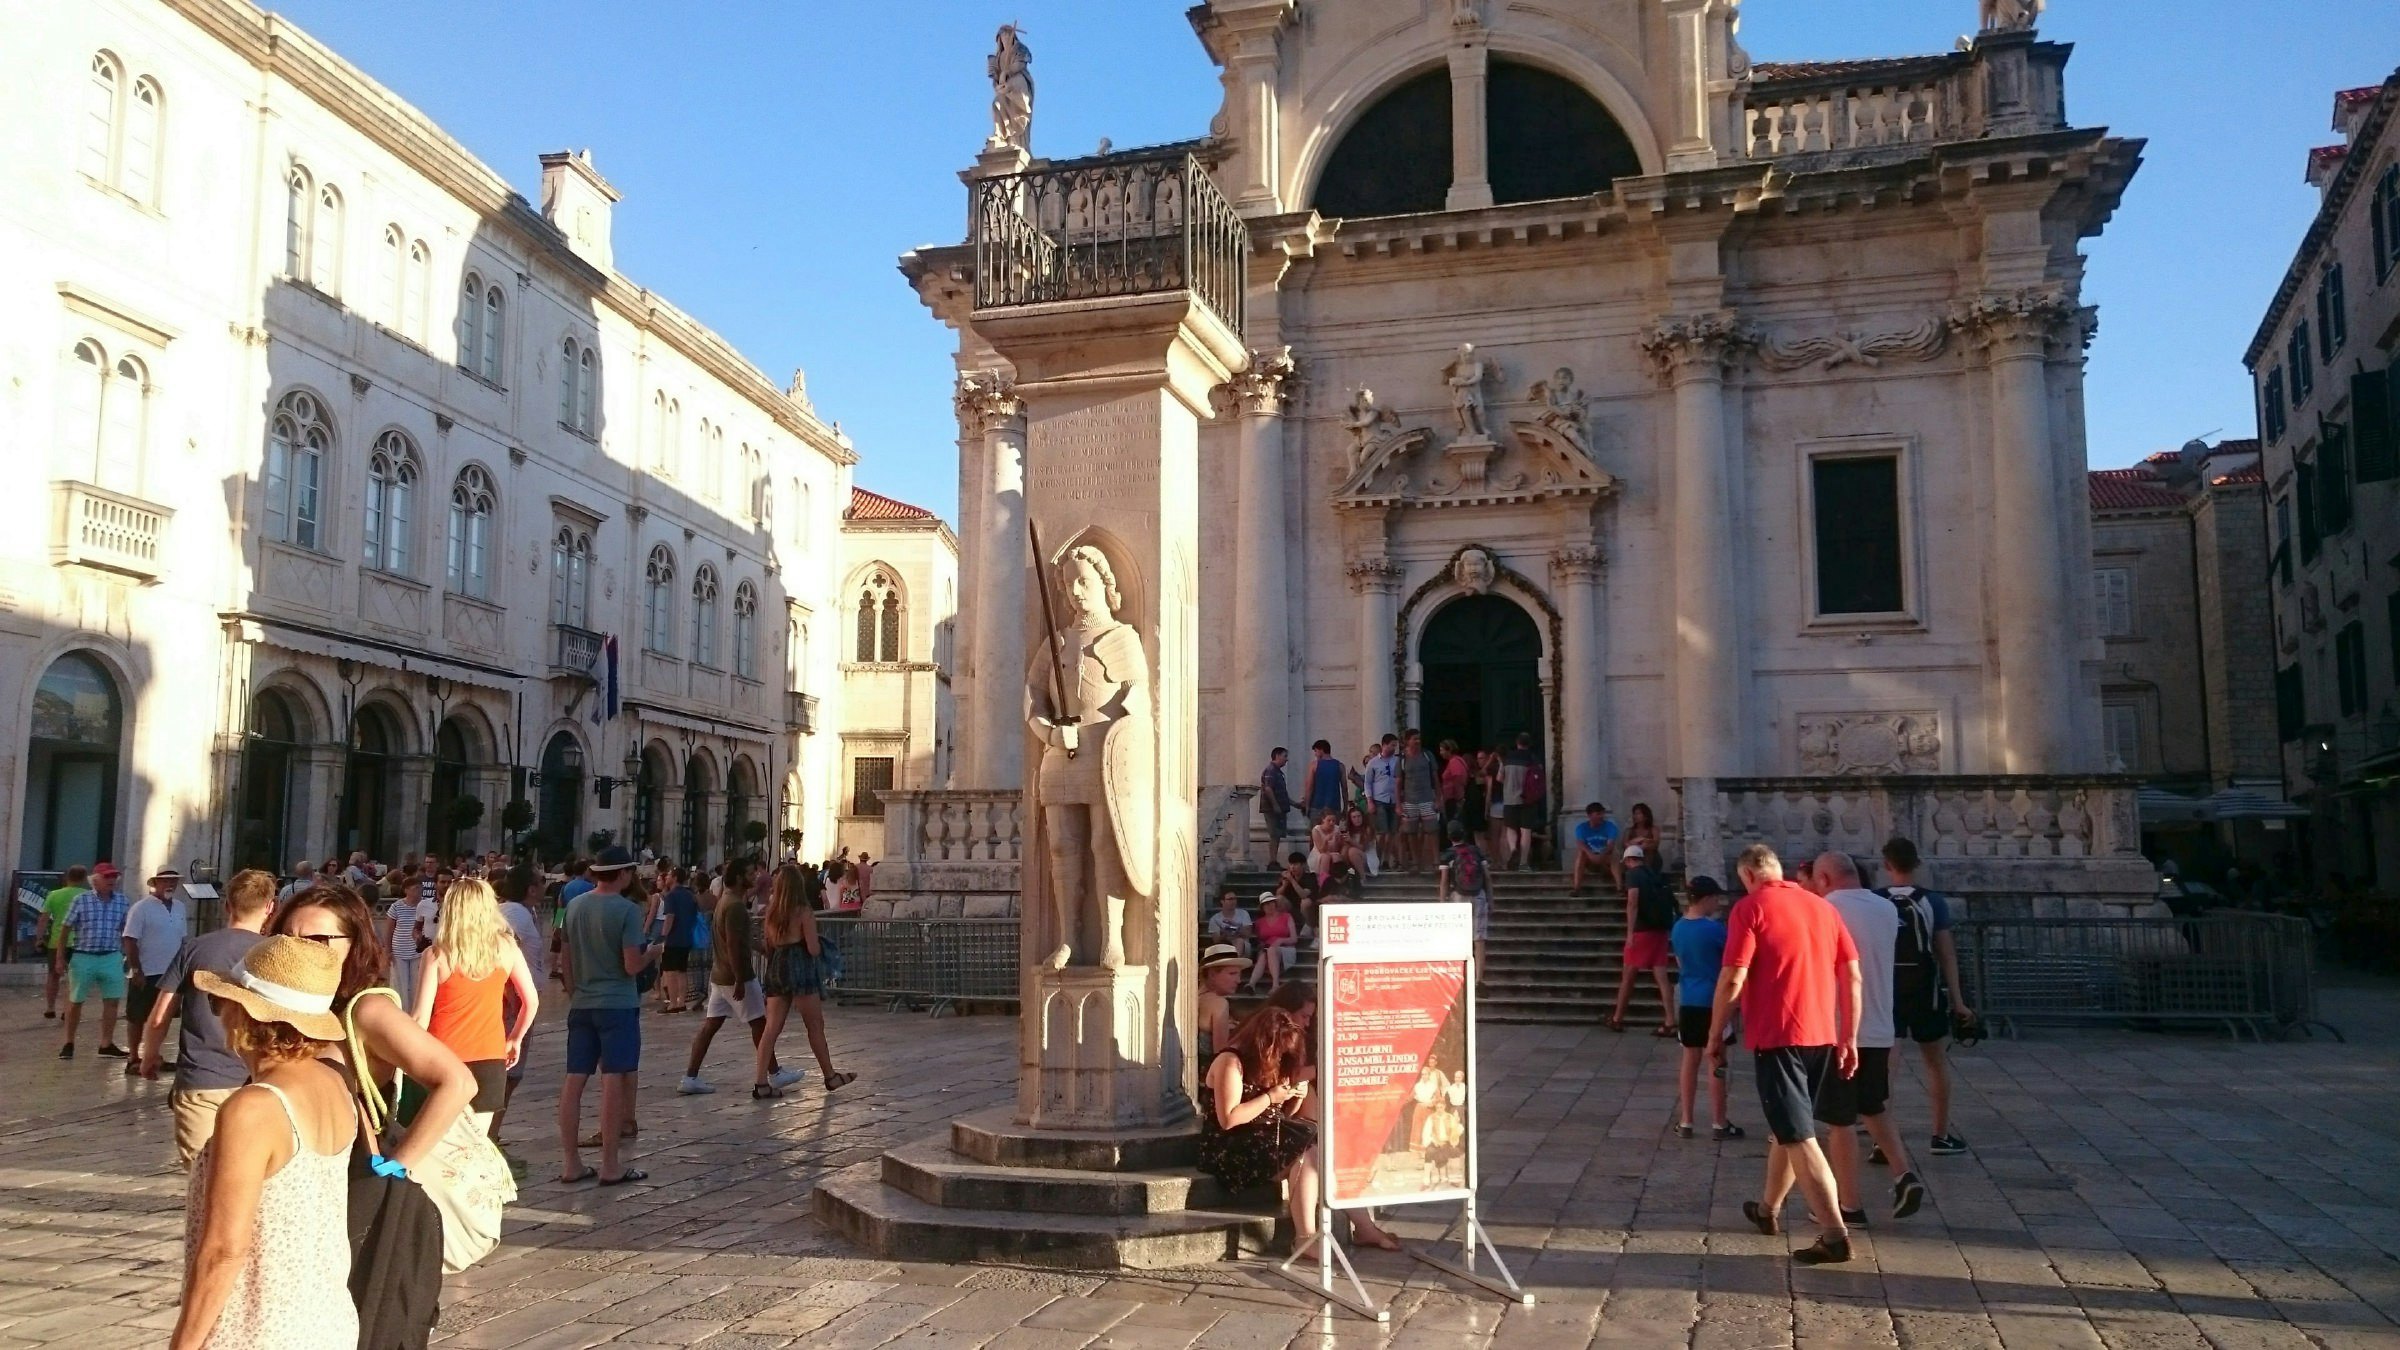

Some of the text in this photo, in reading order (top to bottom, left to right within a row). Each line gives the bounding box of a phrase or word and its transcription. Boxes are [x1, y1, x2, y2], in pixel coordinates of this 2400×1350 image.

[1337, 1033, 1358, 1041] 21.30
[1337, 1045, 1392, 1056] FOLKLORNI
[1338, 1056, 1384, 1066] ANSAMBL
[1370, 1064, 1418, 1075] FOLKLORE
[1338, 1076, 1389, 1087] ENSEMBLE
